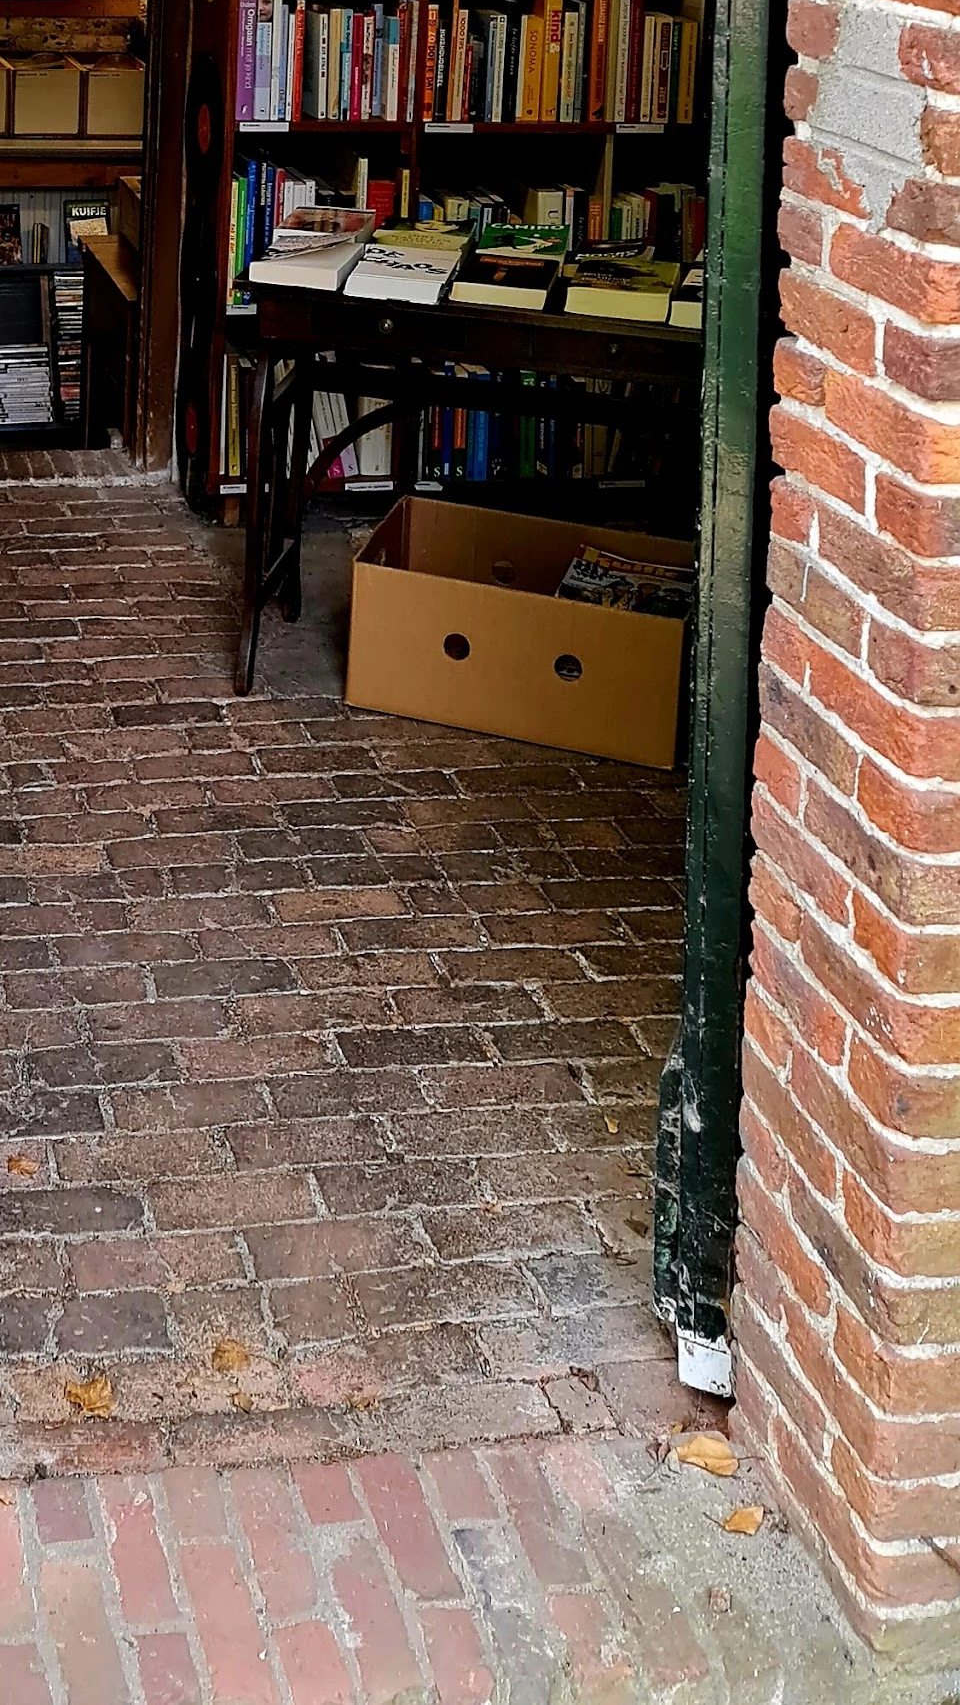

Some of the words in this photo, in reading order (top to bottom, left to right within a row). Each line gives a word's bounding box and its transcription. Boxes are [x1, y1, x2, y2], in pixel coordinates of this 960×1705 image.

[246, 9, 255, 46] Omgaan
[550, 11, 562, 42] kind
[427, 46, 436, 62] DOE
[528, 30, 538, 73] SONOMA
[245, 72, 253, 89] kind
[426, 77, 434, 92] DAT
[71, 206, 107, 217] KUIFJE
[490, 222, 565, 232] CAMINO
